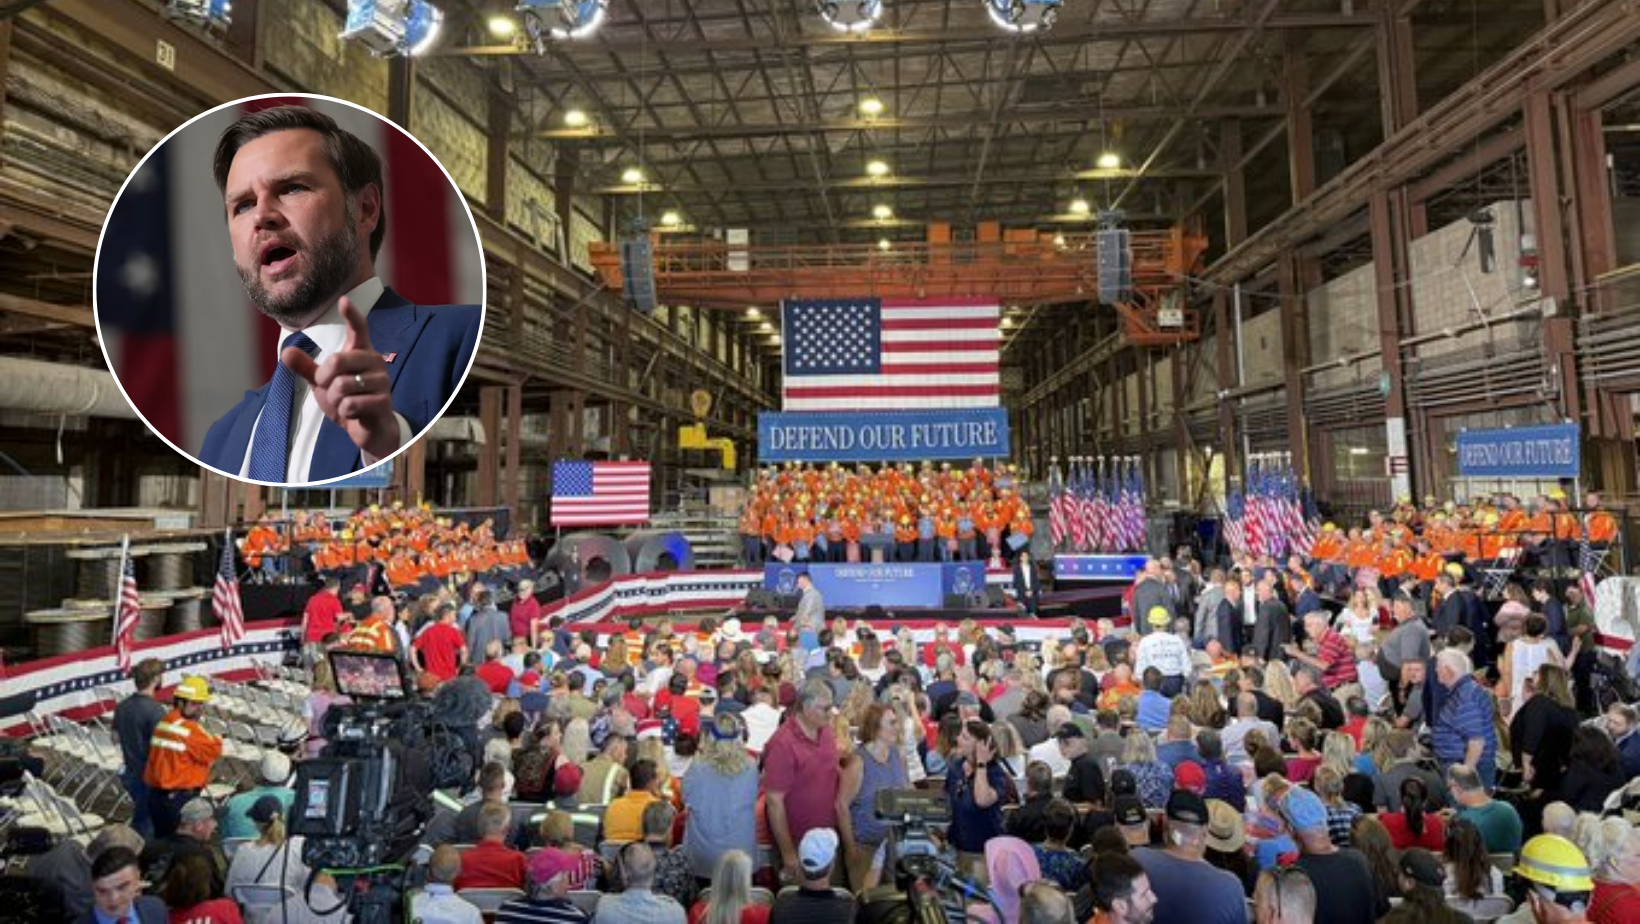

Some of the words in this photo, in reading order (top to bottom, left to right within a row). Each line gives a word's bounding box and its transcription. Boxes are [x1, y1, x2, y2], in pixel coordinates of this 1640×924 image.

[770, 426, 854, 450] DEFEND
[859, 424, 906, 449] OUR
[911, 421, 998, 447] FUTURE
[1461, 443, 1498, 466] DEFEND
[1500, 441, 1524, 465] OUR
[1525, 438, 1573, 464] FUTURE
